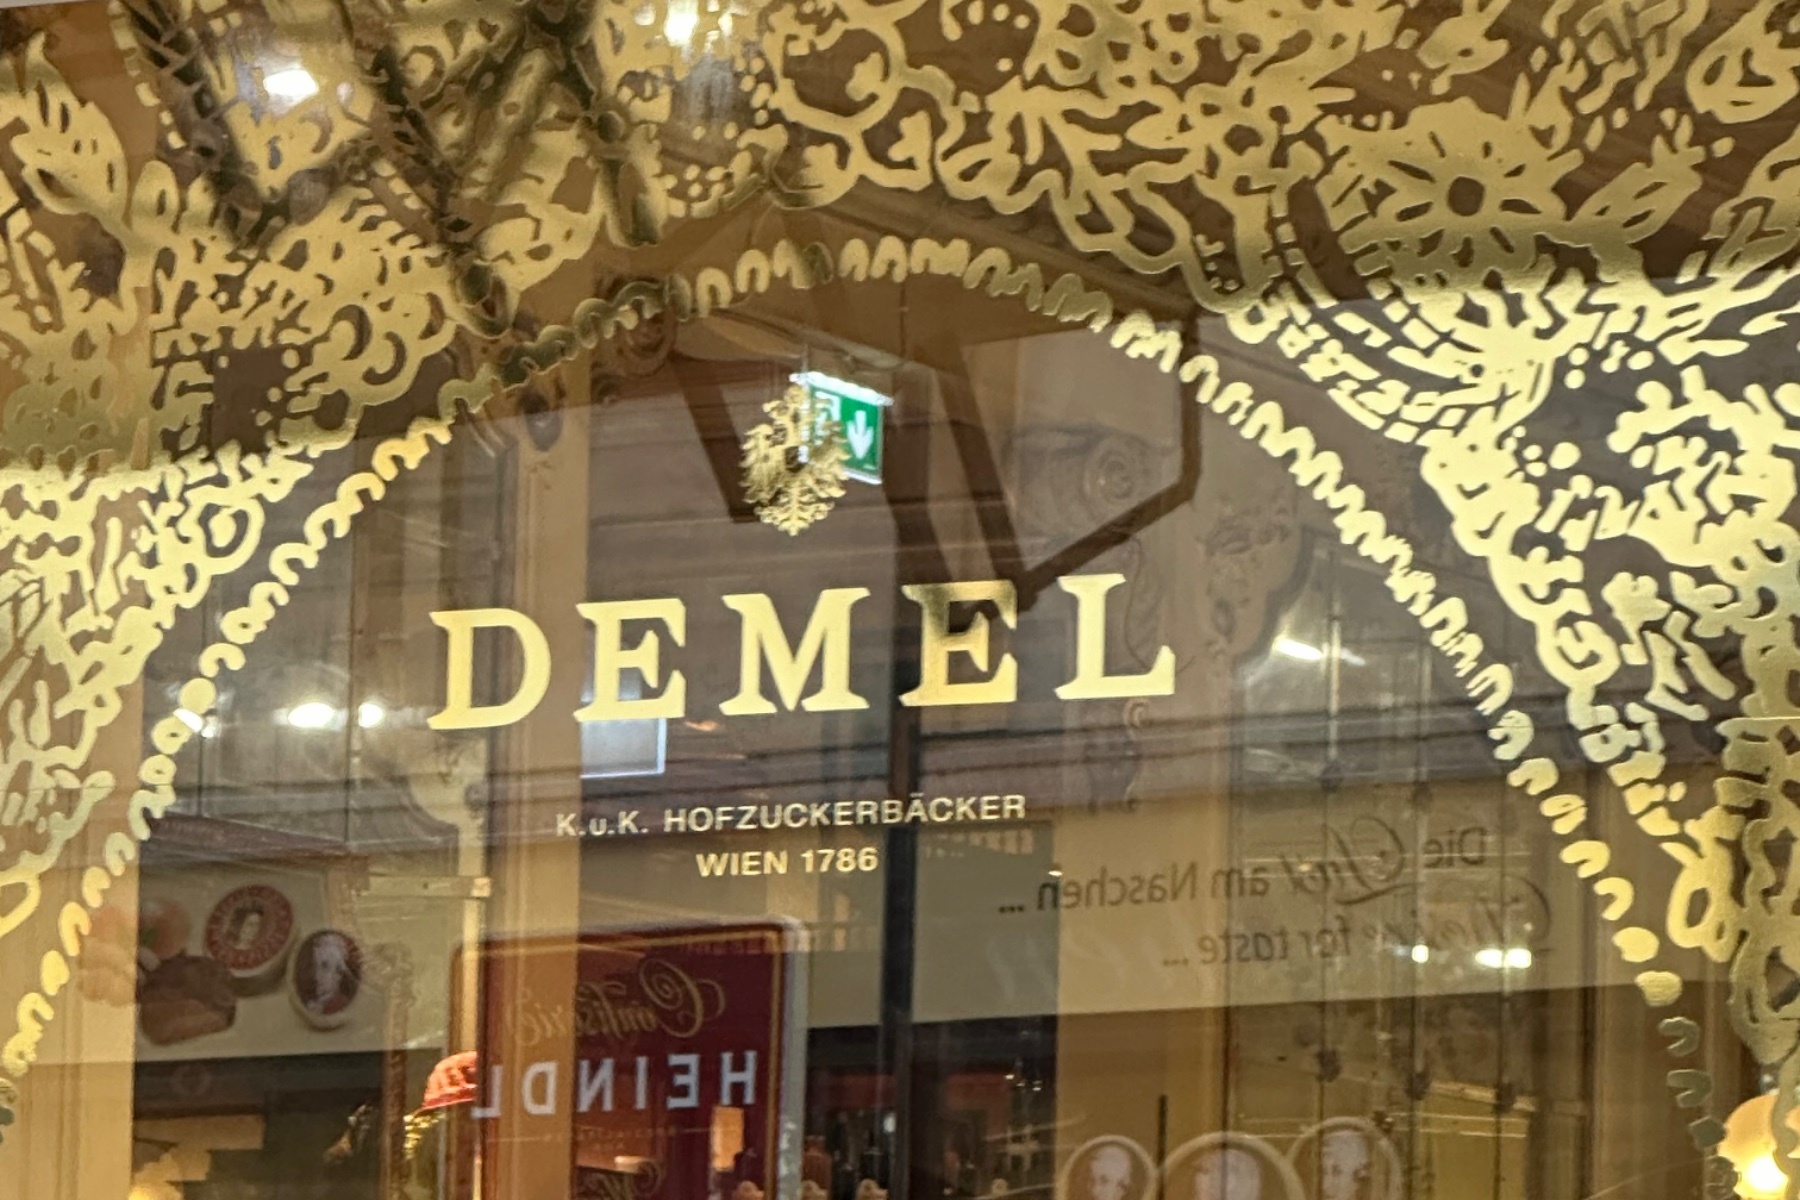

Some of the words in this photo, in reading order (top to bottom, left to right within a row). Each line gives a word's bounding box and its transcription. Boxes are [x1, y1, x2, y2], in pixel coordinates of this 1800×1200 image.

[427, 573, 1176, 730] DEMEL
[556, 809, 649, 838] K.u.K.
[662, 792, 1027, 834] HOFZUCKERBÄCKER
[695, 851, 789, 877] WIEN
[800, 847, 878, 874] 1786
